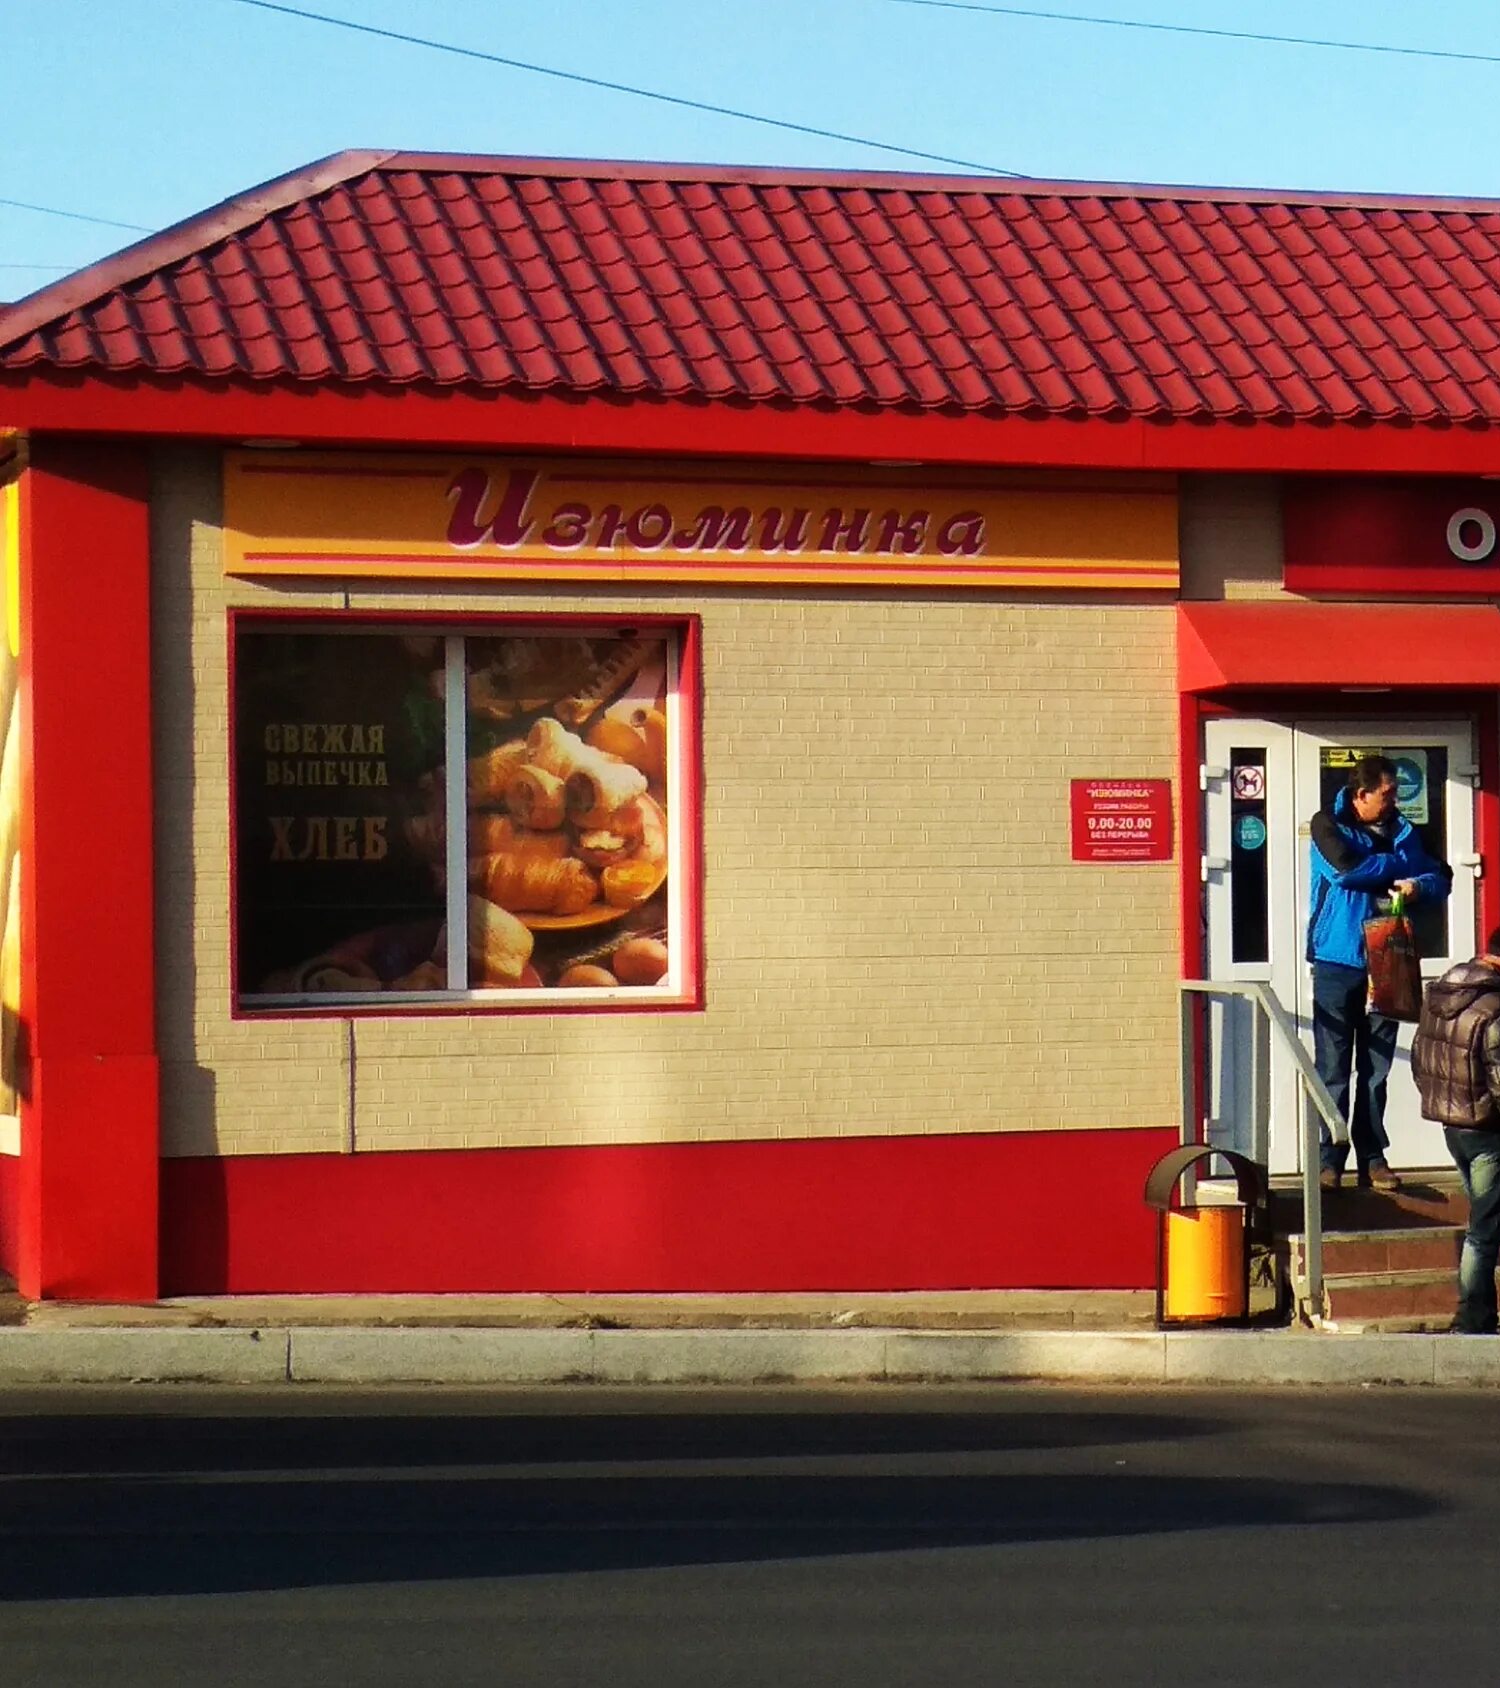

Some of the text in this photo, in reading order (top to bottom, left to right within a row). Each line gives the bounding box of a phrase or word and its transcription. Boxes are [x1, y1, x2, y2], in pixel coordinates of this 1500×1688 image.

[445, 467, 987, 556] Изюминка
[264, 724, 385, 753] СВЕЖАЯ
[265, 760, 389, 785] ВЫПЕЧКА
[268, 817, 389, 861] ХЛЕБ
